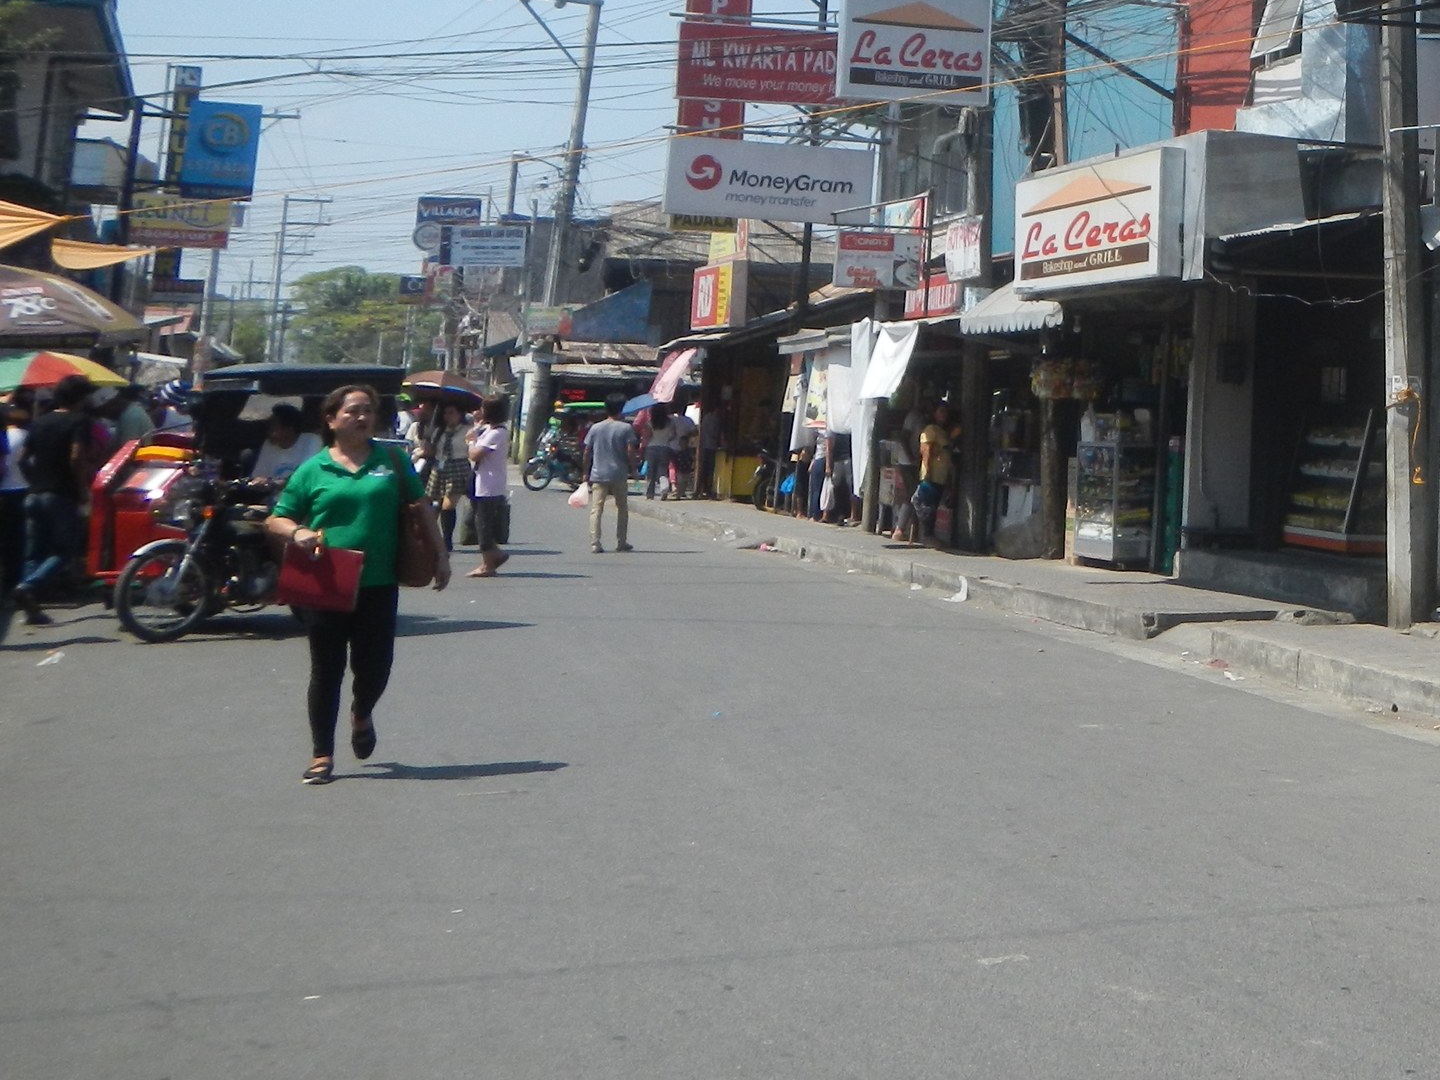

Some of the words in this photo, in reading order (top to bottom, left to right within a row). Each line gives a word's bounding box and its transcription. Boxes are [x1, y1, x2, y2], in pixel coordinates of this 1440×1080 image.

[850, 30, 892, 65] La
[899, 33, 983, 72] Ceras
[703, 74, 721, 86] We
[725, 77, 756, 89] move
[759, 80, 784, 92] your
[787, 82, 827, 95] money
[874, 71, 909, 86] Bakeshop
[925, 75, 958, 87] GRILL
[728, 169, 854, 194] MoneyGram
[1022, 221, 1058, 261] La
[1064, 210, 1151, 251] Ceras
[1042, 260, 1074, 274] Bakeshop
[1074, 256, 1088, 268] and
[1089, 248, 1122, 266] GRILL
